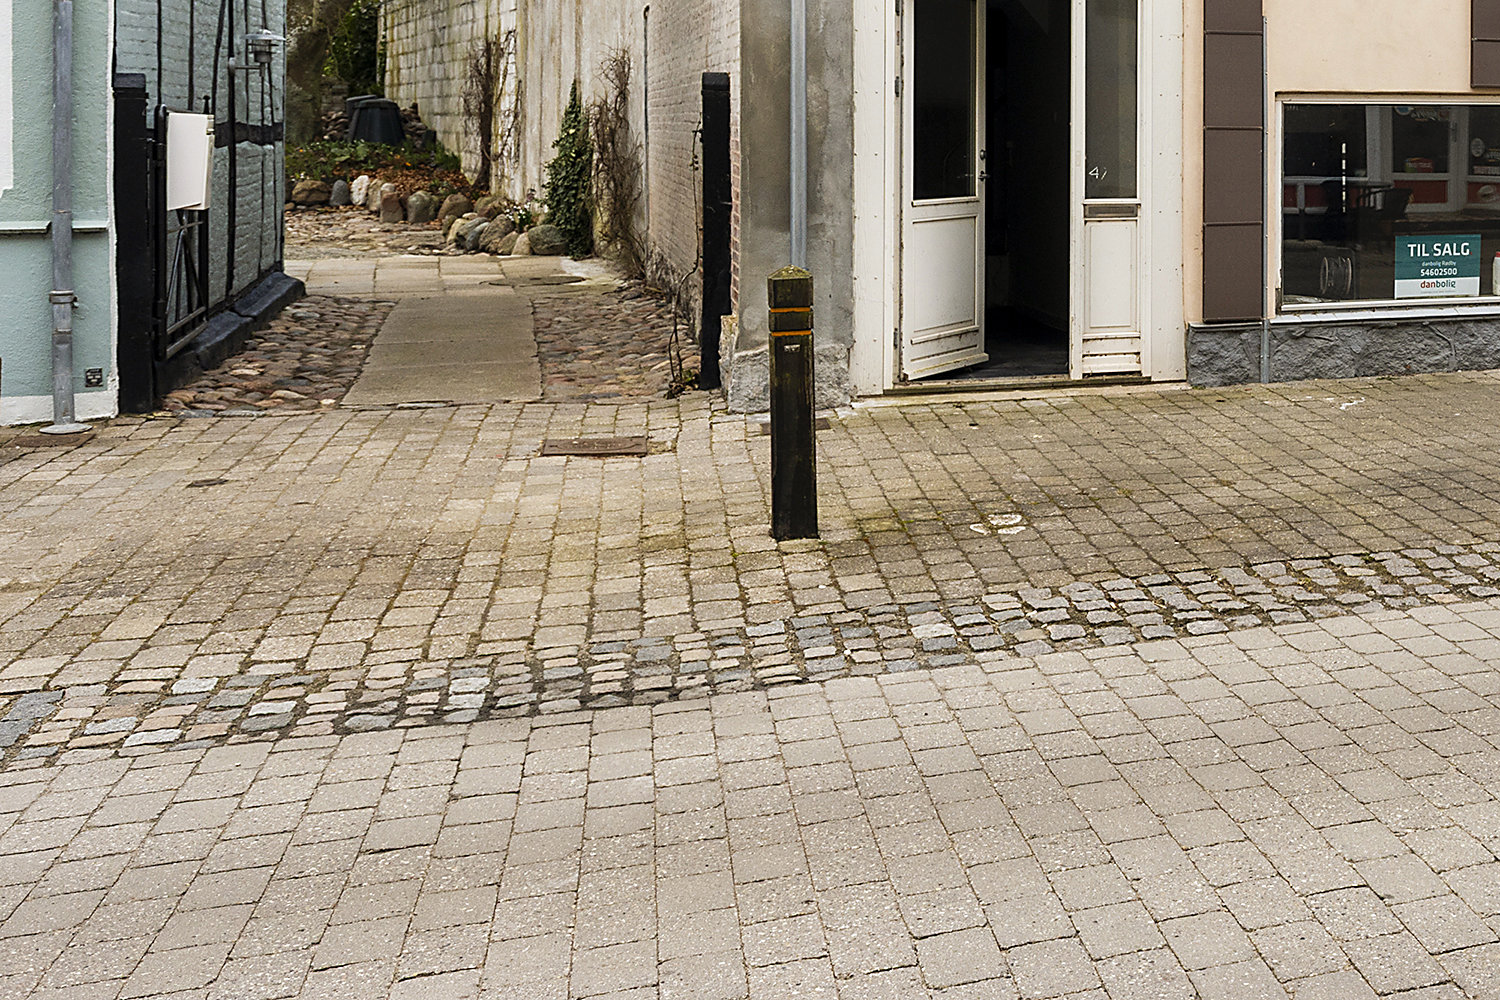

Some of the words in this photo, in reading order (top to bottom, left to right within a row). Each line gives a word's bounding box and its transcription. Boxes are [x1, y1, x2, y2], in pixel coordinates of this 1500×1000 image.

[1407, 243, 1430, 257] TIL
[1420, 267, 1458, 277] 54602500
[1420, 279, 1456, 289] danbolig
